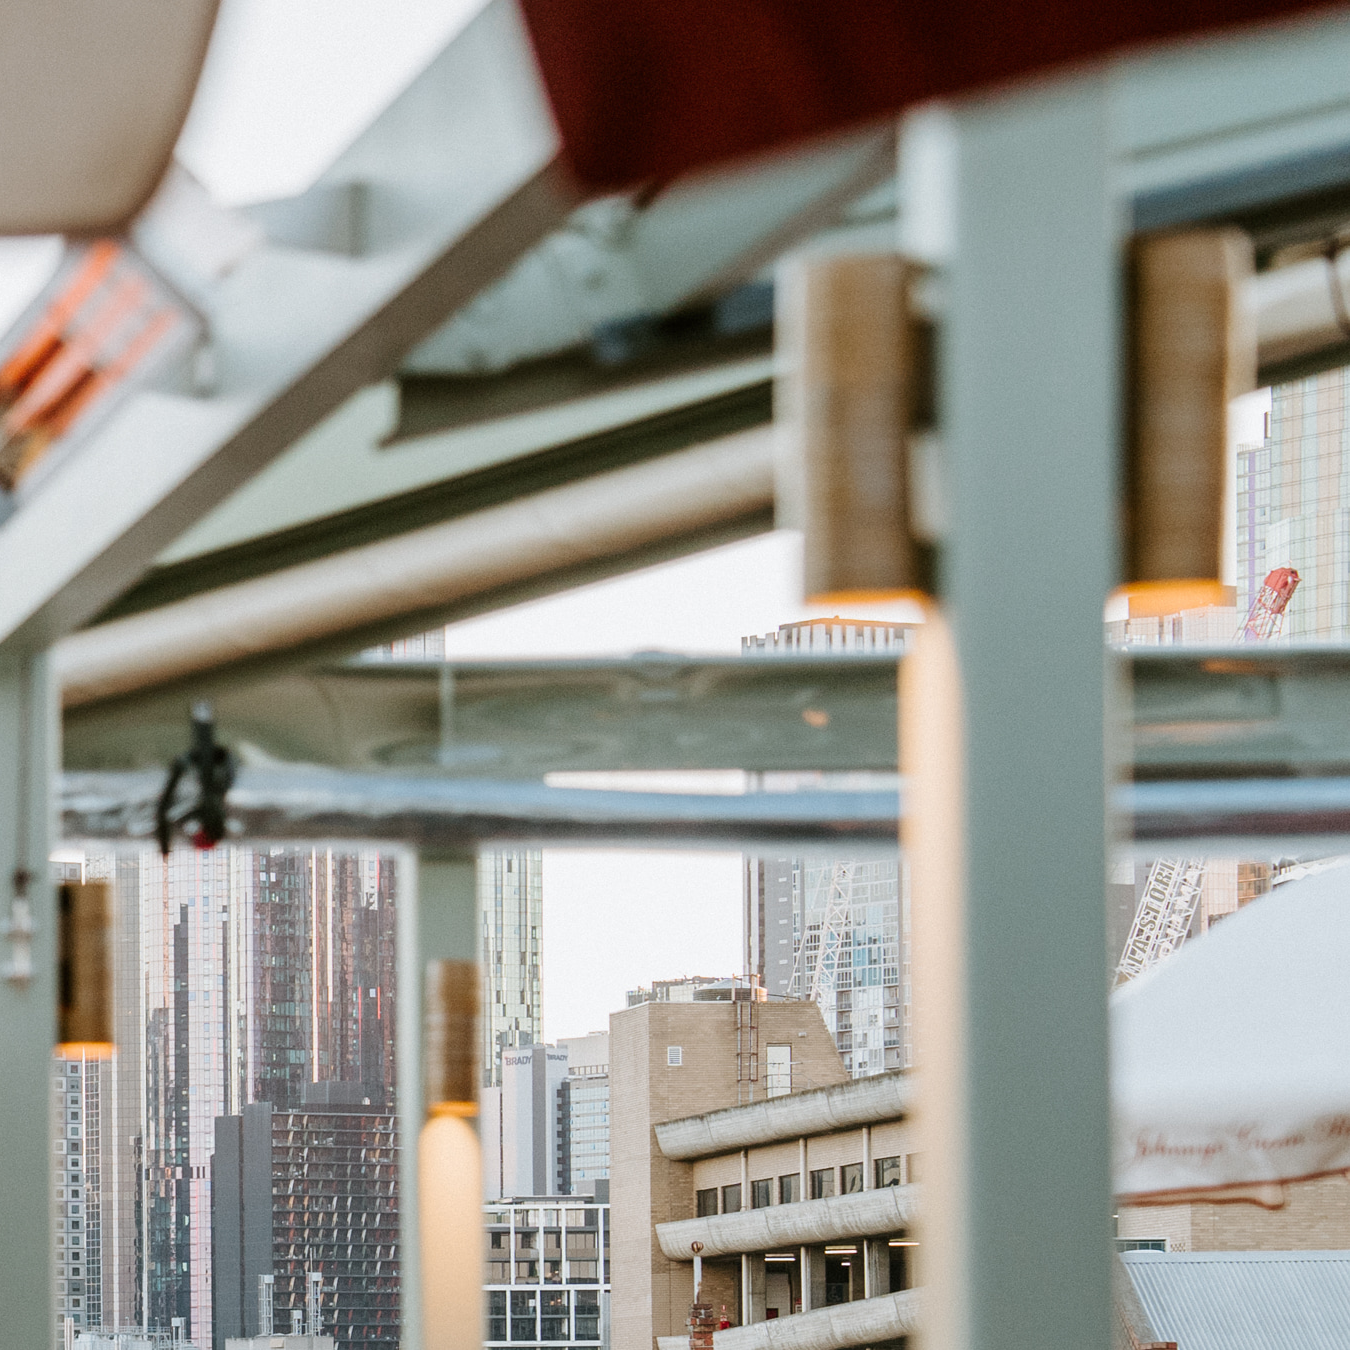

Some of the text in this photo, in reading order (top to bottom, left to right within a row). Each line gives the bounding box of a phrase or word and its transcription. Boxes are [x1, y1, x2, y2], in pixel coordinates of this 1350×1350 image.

[1140, 861, 1176, 931] STORI
[505, 1055, 532, 1066] BRADY
[547, 1053, 568, 1062] BRADY
